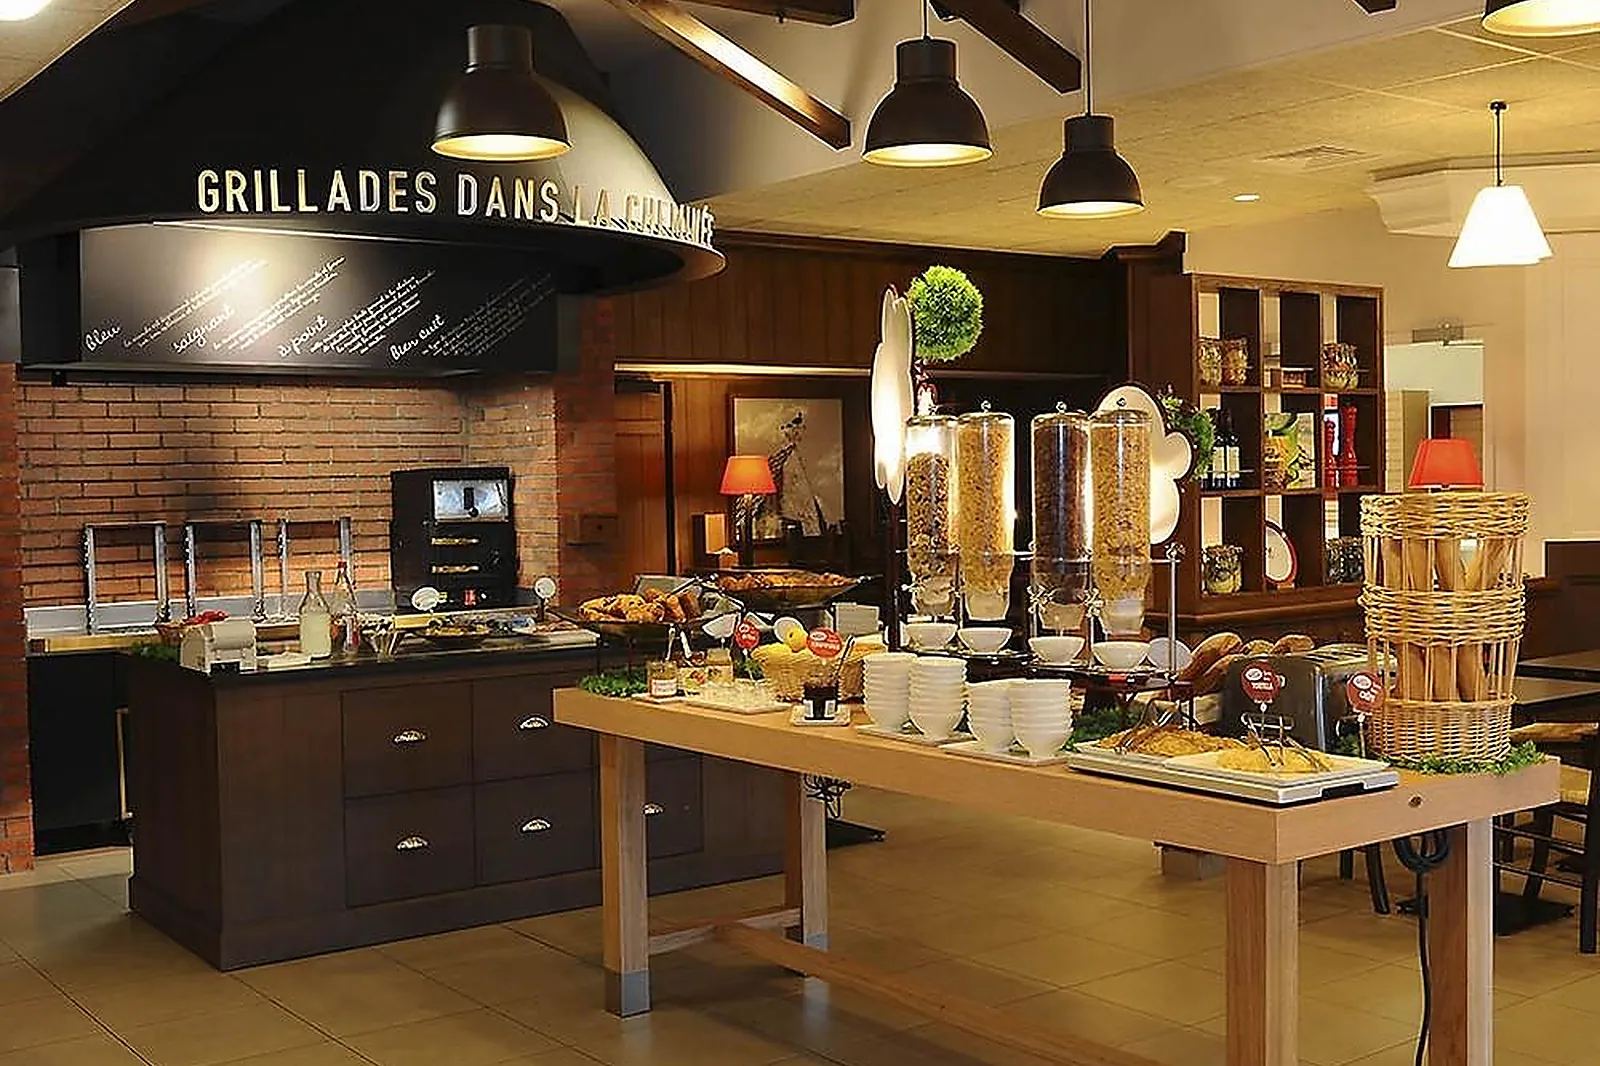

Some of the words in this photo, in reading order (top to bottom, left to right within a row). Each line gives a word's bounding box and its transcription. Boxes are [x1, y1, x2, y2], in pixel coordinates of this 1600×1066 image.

[198, 168, 437, 213] GRILLADES
[457, 173, 560, 222] DANS
[573, 185, 610, 227] LA
[173, 304, 235, 353] saignant
[288, 314, 328, 355] point
